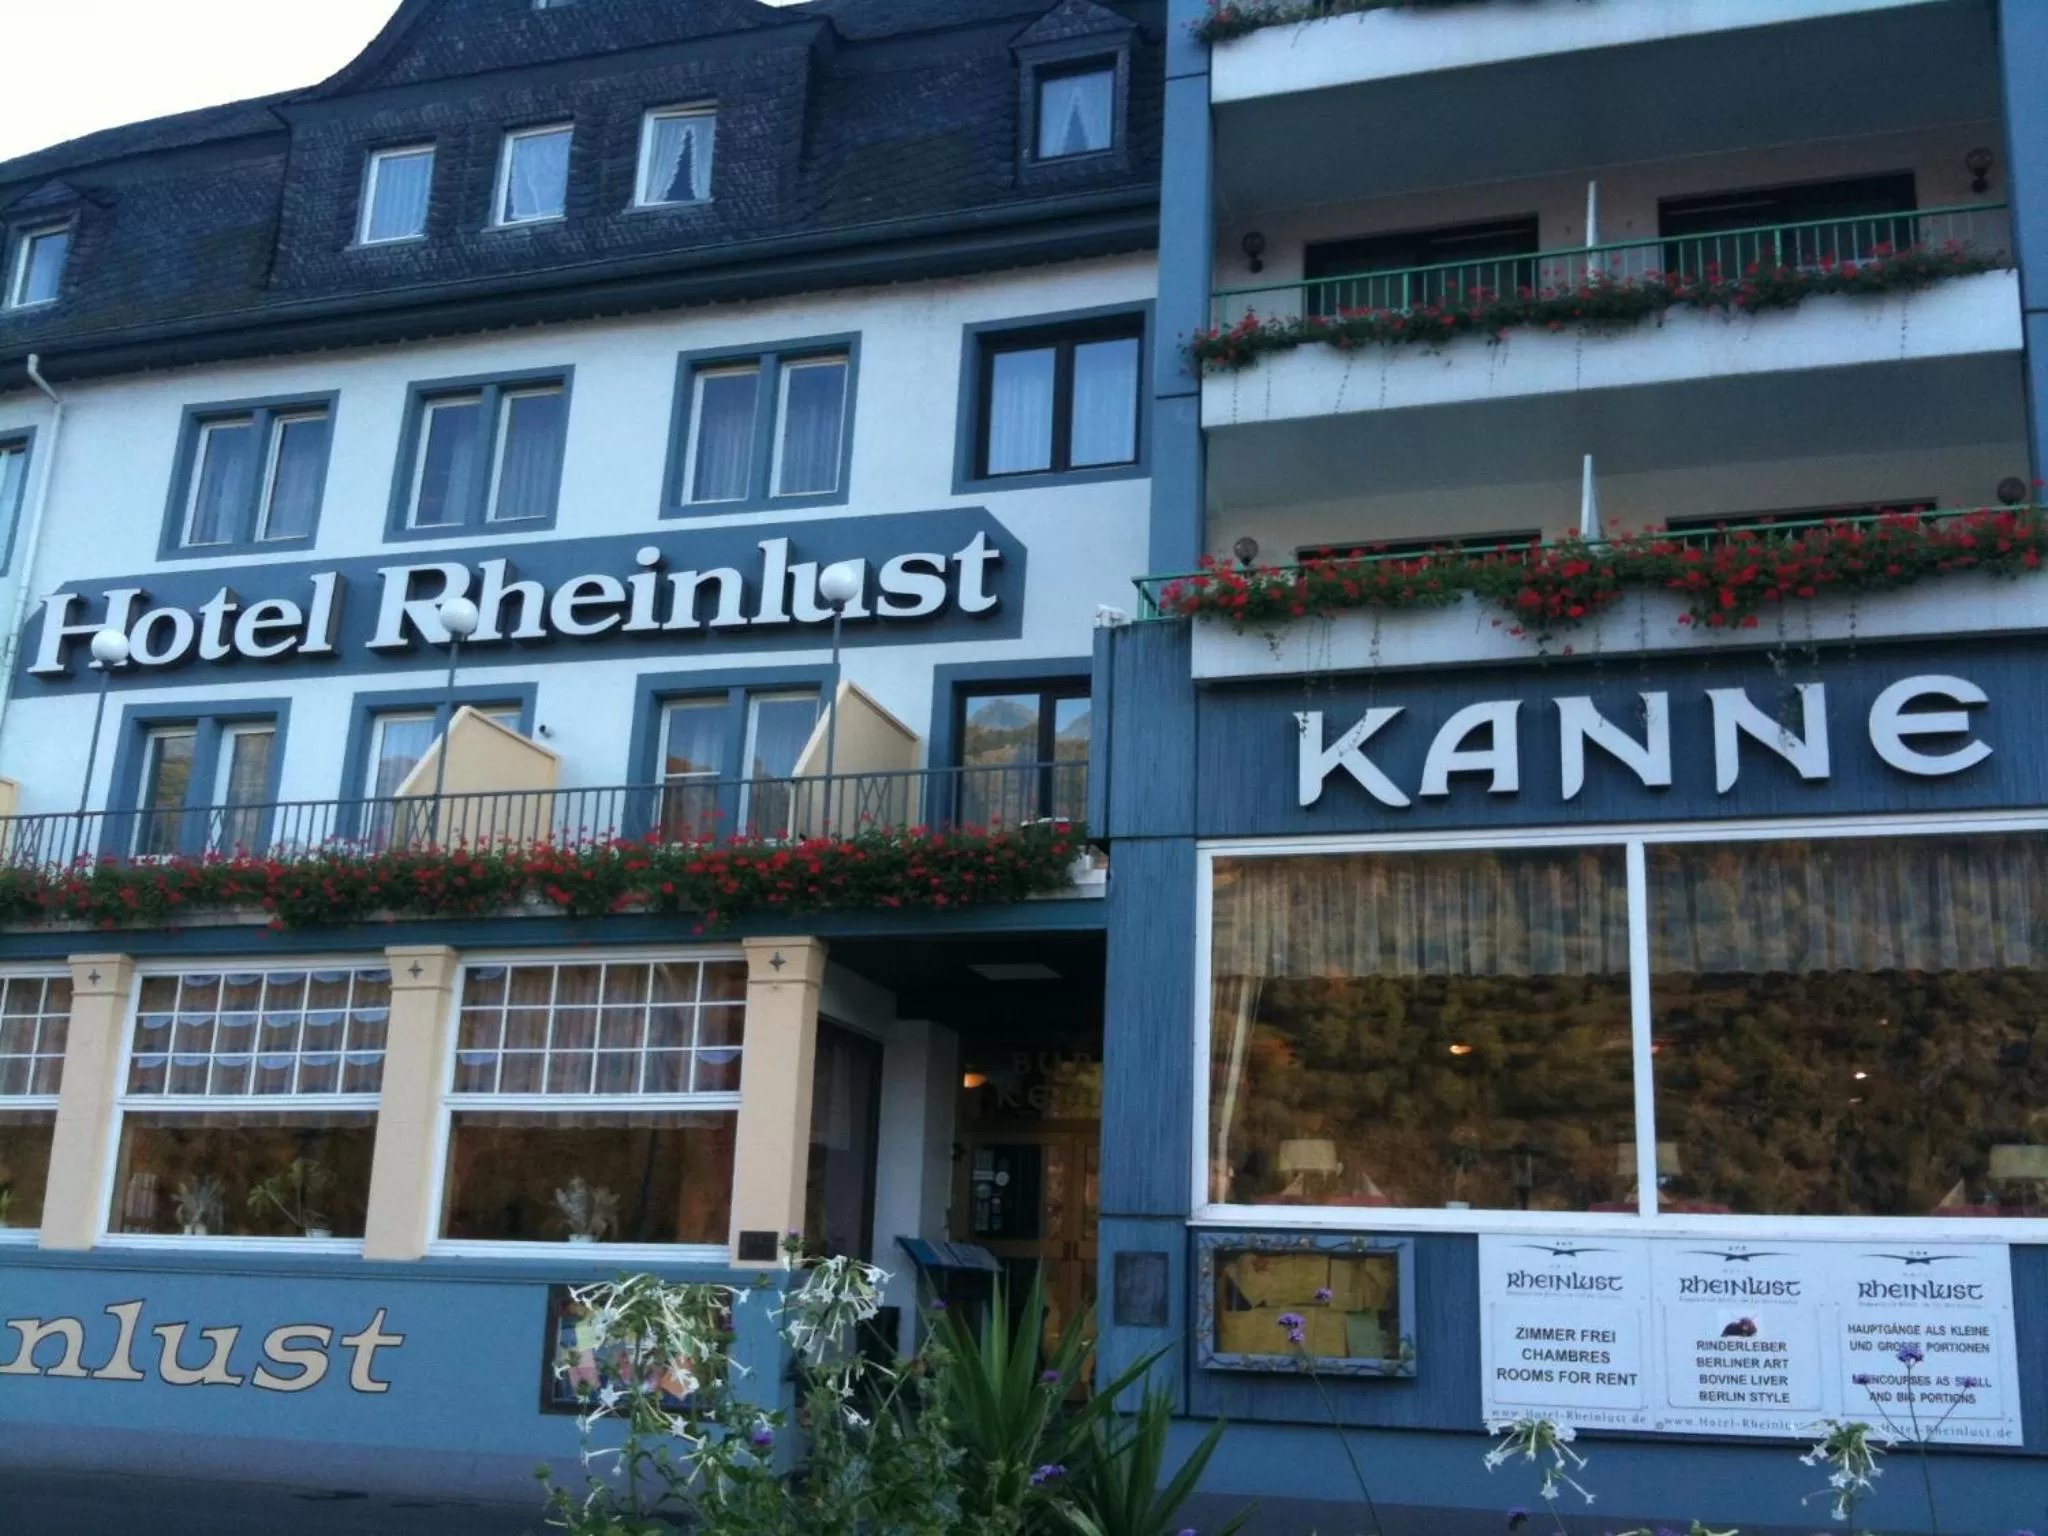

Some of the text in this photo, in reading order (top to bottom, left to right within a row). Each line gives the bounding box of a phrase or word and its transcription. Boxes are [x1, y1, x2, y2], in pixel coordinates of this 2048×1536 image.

[26, 530, 1002, 674] Hotel Rheinlust
[1293, 673, 1994, 808] KANNE
[1515, 1327, 1616, 1344] ZIMMER FREI
[1847, 1323, 1990, 1337] HAUPTGÄNGE ALS KLEINE
[0, 1298, 407, 1393] nlust
[1696, 1340, 1787, 1353] RINDERLEBER
[1849, 1340, 1873, 1351] UND
[1926, 1342, 1990, 1354] PORTIONEN
[1521, 1347, 1611, 1364] CHAMBRES
[1696, 1357, 1790, 1370] BERLINER ART
[1496, 1367, 1638, 1387] ROOMS FOR RENT
[1698, 1374, 1789, 1387] BOVINE LIVER
[1935, 1375, 1950, 1387] AS
[1698, 1391, 1791, 1404] BERLIN STYLE
[1869, 1391, 1892, 1402] AND
[1920, 1392, 1977, 1405] PORTIONS
